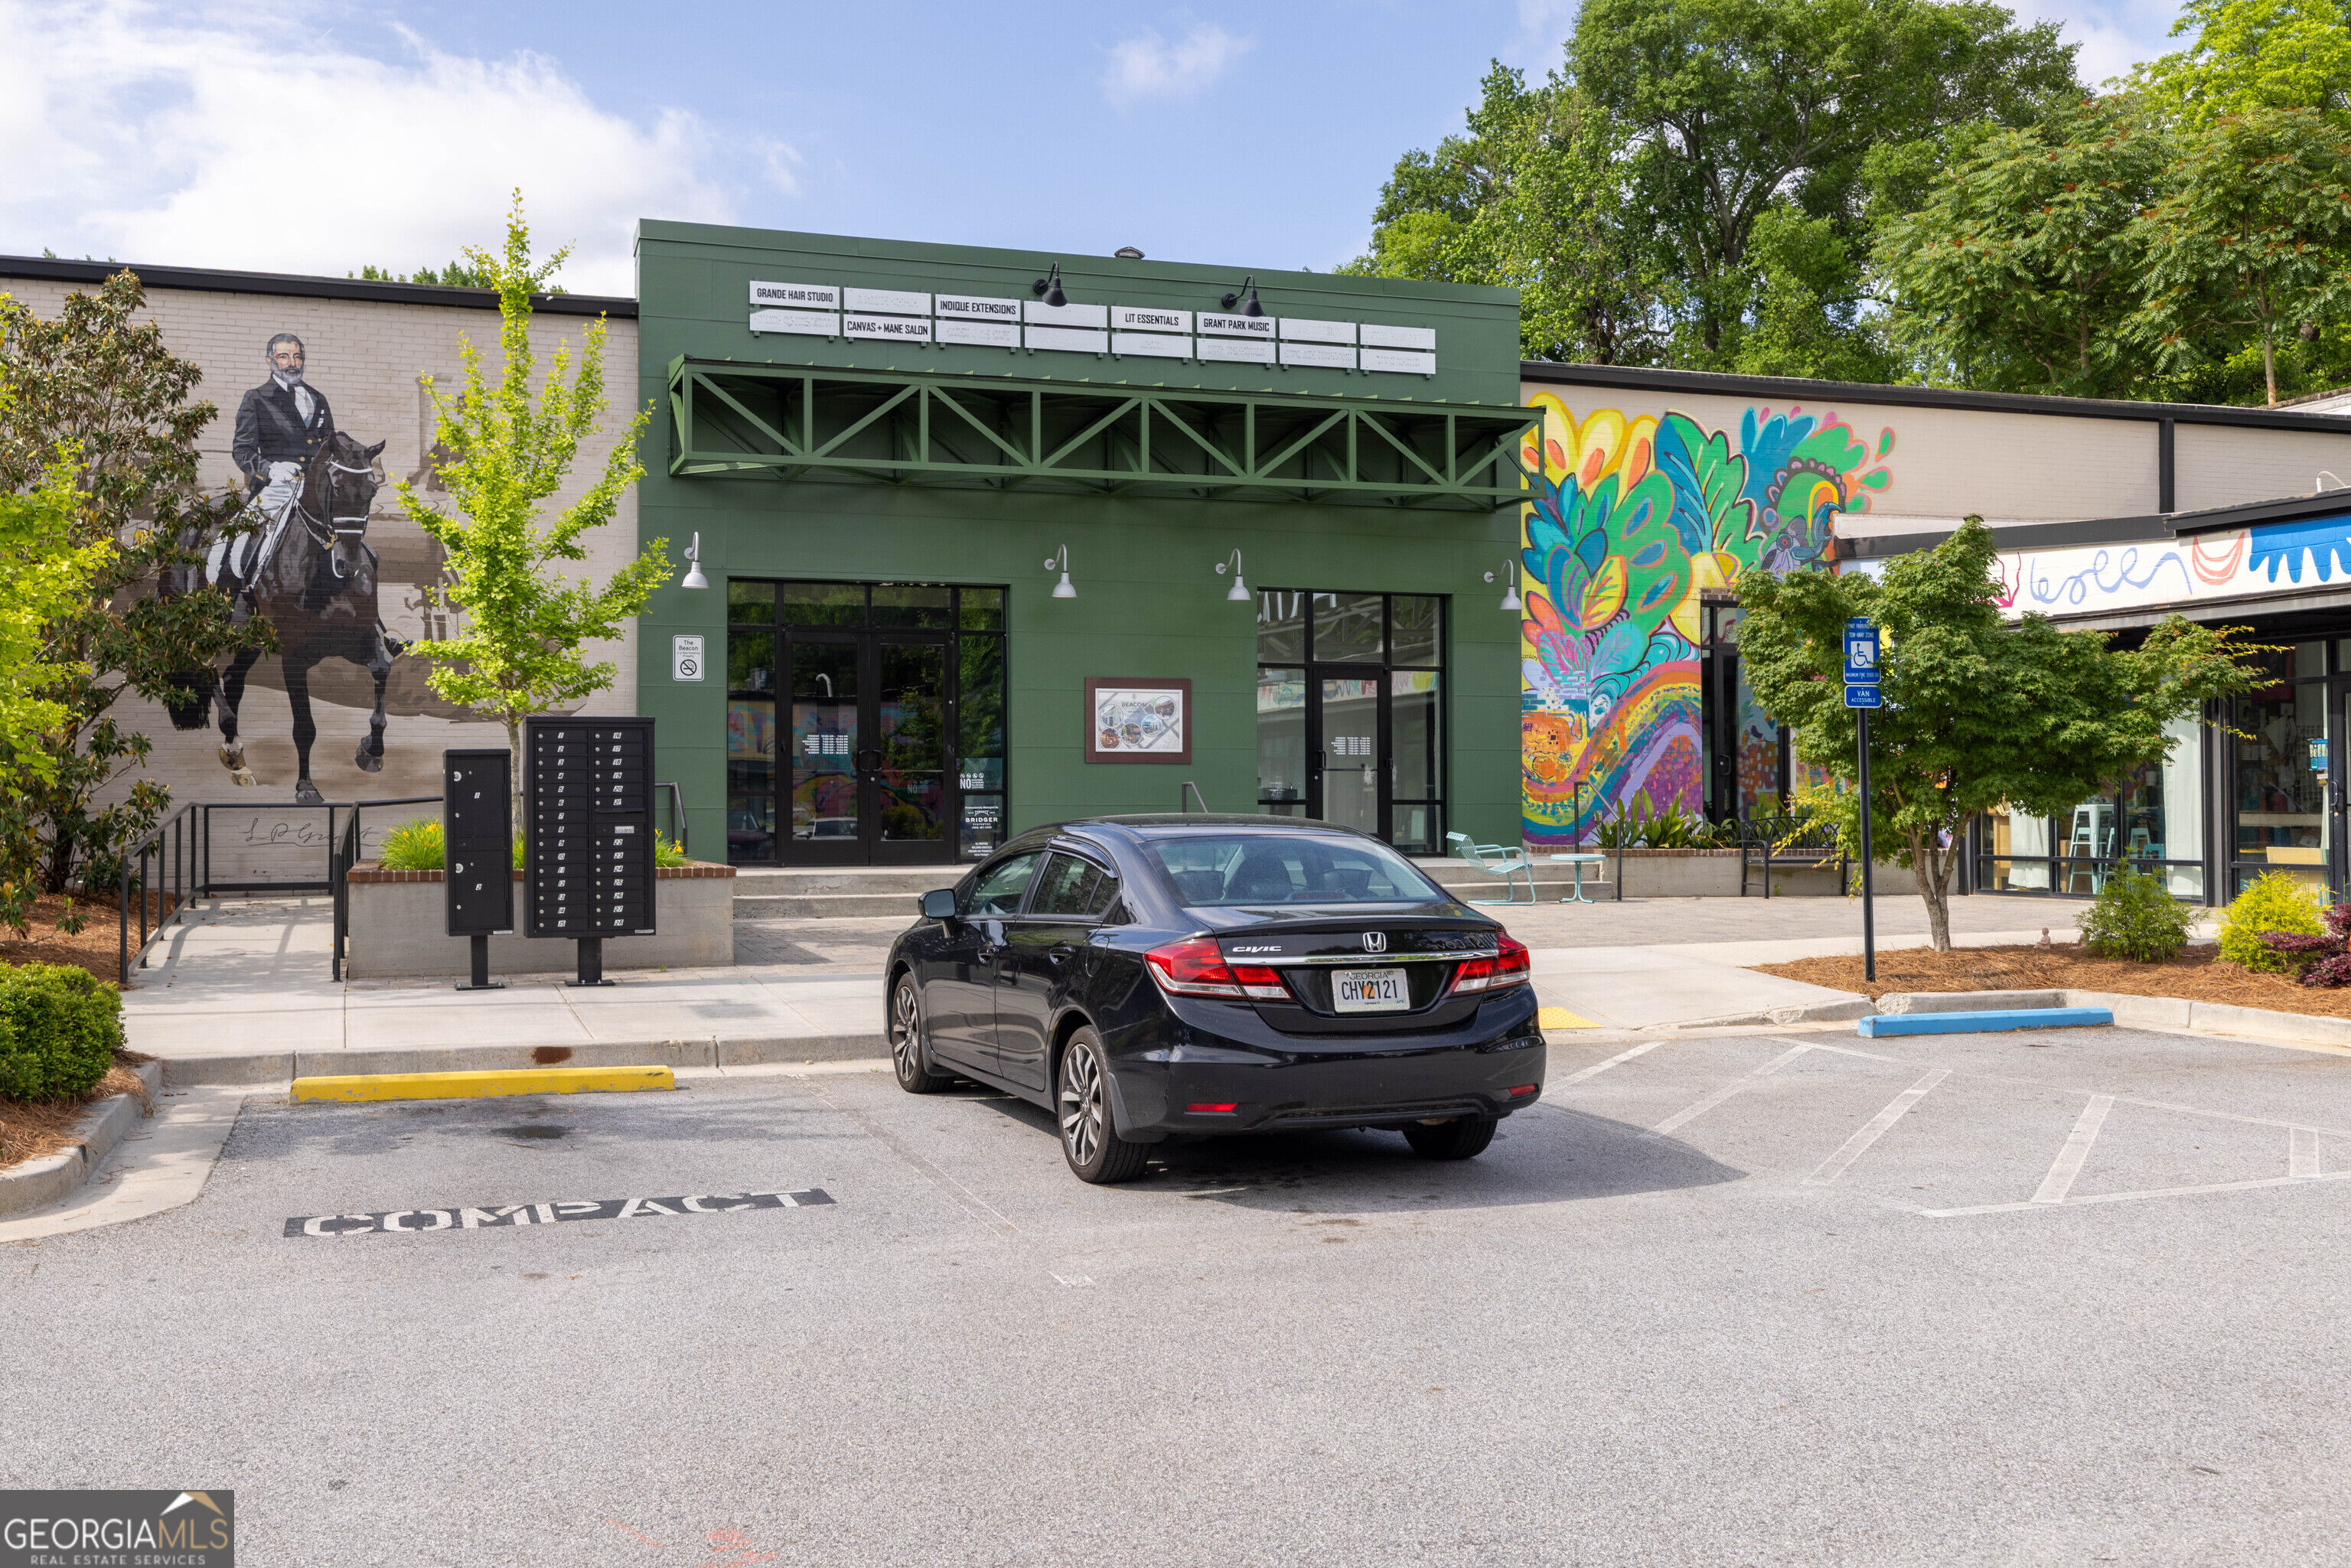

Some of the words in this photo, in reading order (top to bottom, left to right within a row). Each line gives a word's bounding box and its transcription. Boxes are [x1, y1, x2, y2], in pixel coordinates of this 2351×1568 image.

[757, 288, 786, 299] GRANDE
[788, 290, 806, 301] HAIR
[807, 292, 833, 302] STUDIO
[940, 300, 970, 311] INDIQUE
[972, 302, 1016, 315] EXTENSIONS
[1125, 313, 1136, 323] LIT
[1137, 315, 1179, 326] ESSENTIALS
[1204, 318, 1226, 328] GRANT
[1228, 320, 1246, 330] PARK
[1248, 321, 1270, 331] MUSIC
[847, 321, 876, 332] CANVAS
[883, 323, 903, 334] MANE
[905, 324, 928, 335] SALON
[960, 778, 972, 789] NO
[1232, 945, 1282, 954] CIVIC
[1349, 972, 1389, 980] GEORGIA
[1342, 980, 1398, 1000] CHY2121
[304, 1188, 813, 1236] COMPACT
